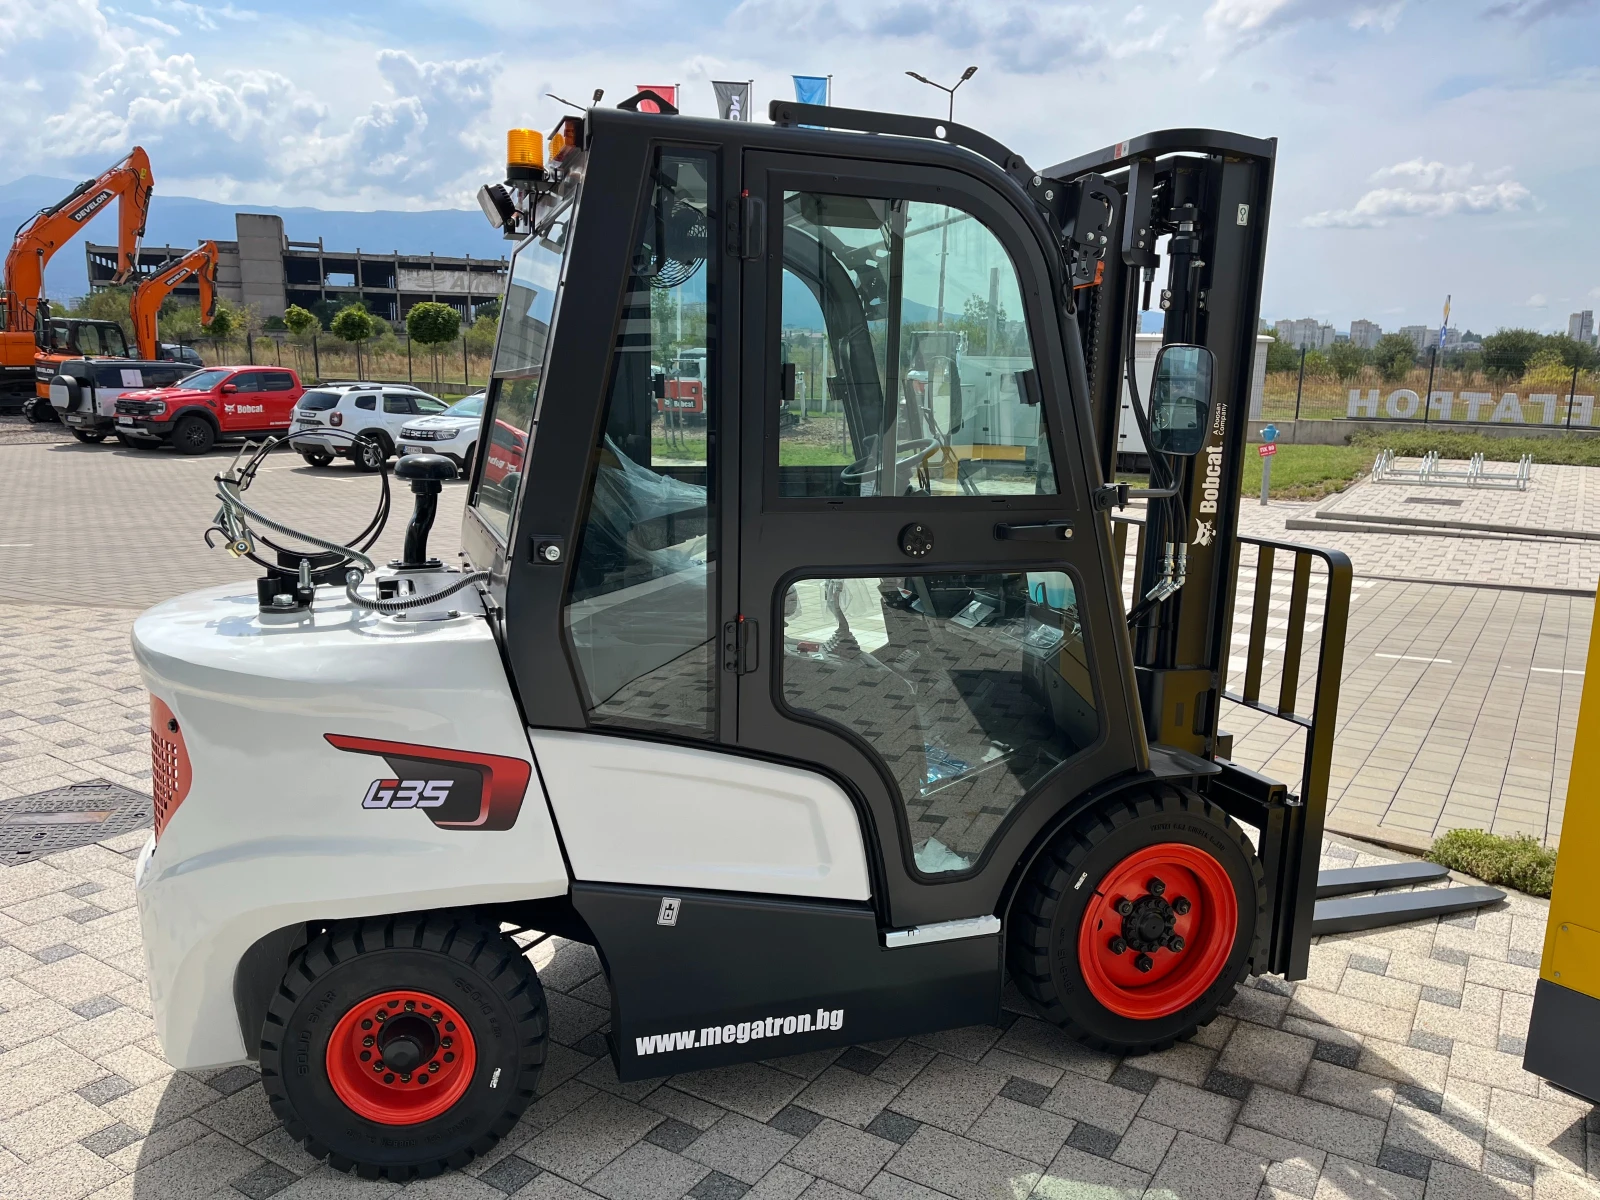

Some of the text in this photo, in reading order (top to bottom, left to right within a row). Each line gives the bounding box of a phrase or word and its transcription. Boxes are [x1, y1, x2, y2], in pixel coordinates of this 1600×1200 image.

[75, 192, 108, 220] DEVELON
[237, 404, 263, 414] Bobcat
[1213, 402, 1222, 429] Doosan
[1218, 403, 1228, 436] Company
[1200, 446, 1224, 513] Bobcat
[361, 779, 454, 809] G35
[296, 991, 337, 1076] SOLID STAR
[635, 1008, 844, 1056] www.megatron.bg
